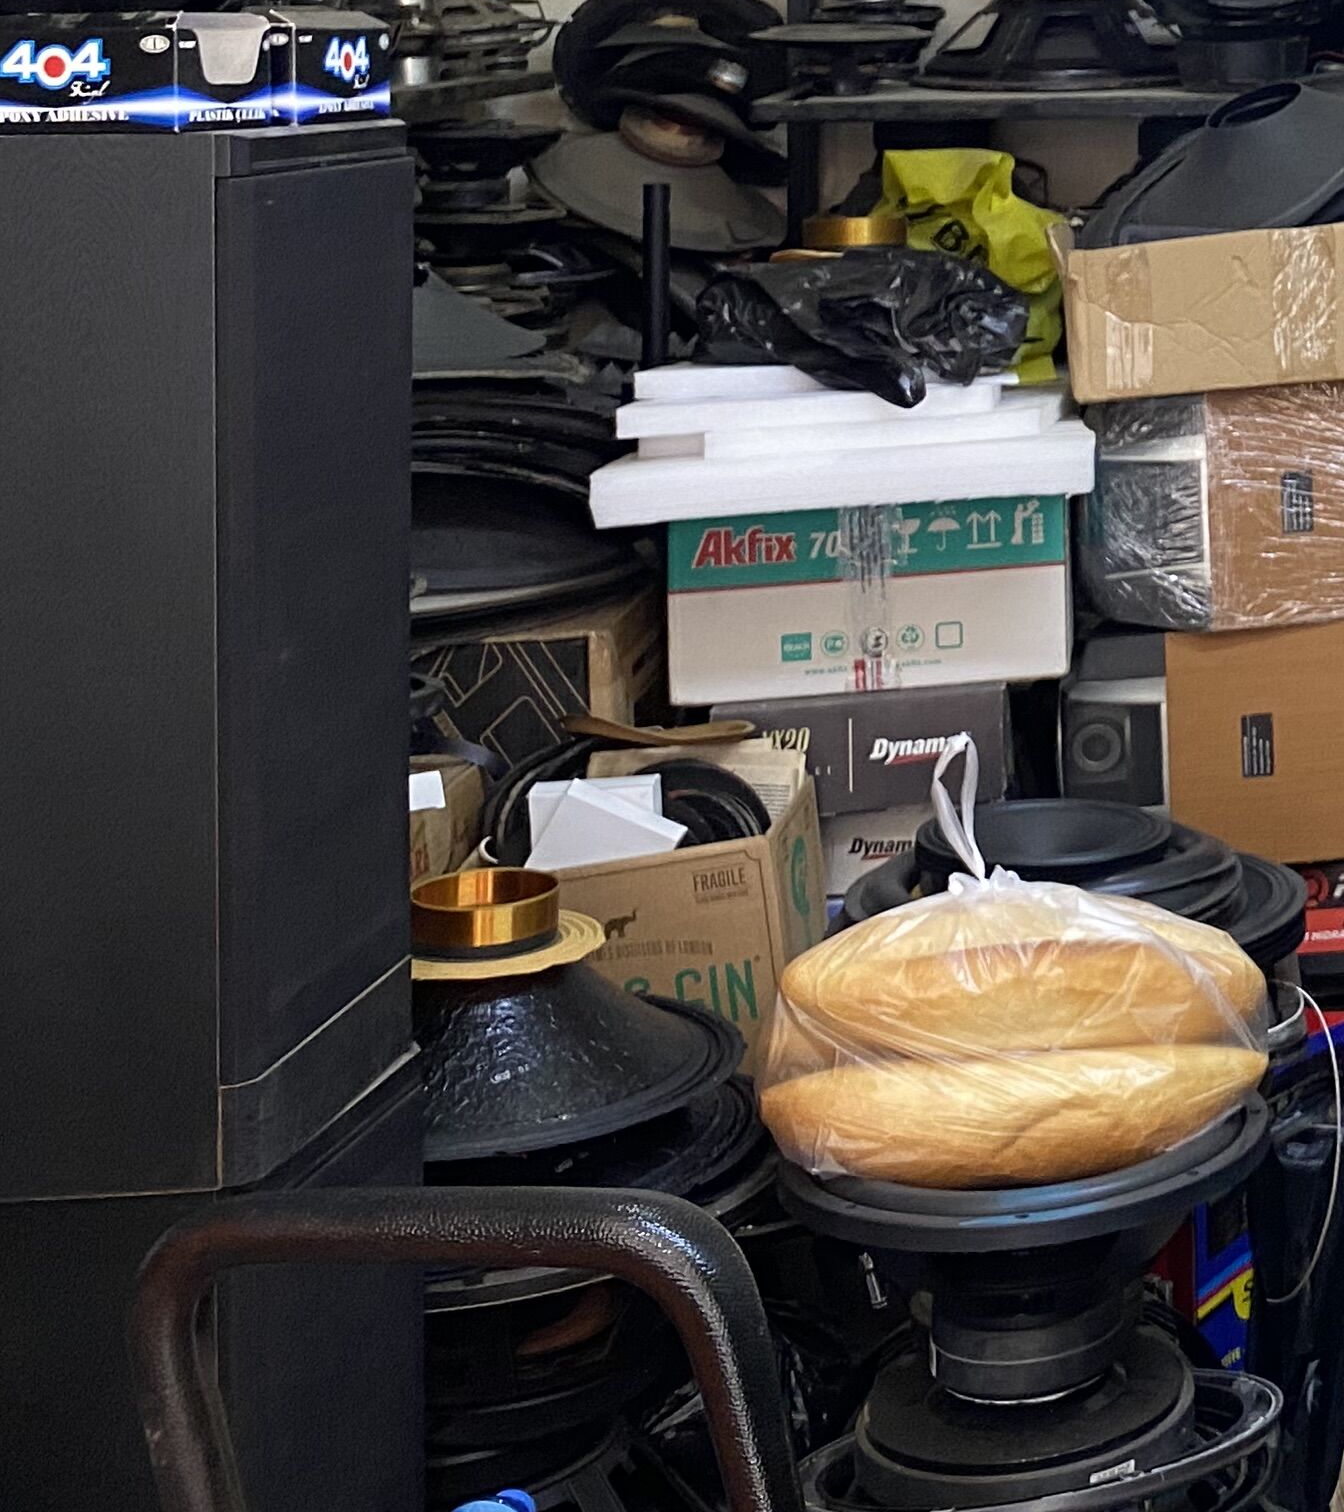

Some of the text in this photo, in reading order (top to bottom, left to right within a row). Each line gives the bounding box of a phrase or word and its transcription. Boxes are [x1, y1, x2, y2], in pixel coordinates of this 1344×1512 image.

[0, 38, 111, 90] 404
[324, 35, 370, 83] 404
[0, 109, 41, 124] POXY
[692, 525, 798, 569] Akfix
[869, 734, 952, 766] Dynam
[848, 837, 914, 856] Dynam
[692, 866, 748, 893] FRAGILE
